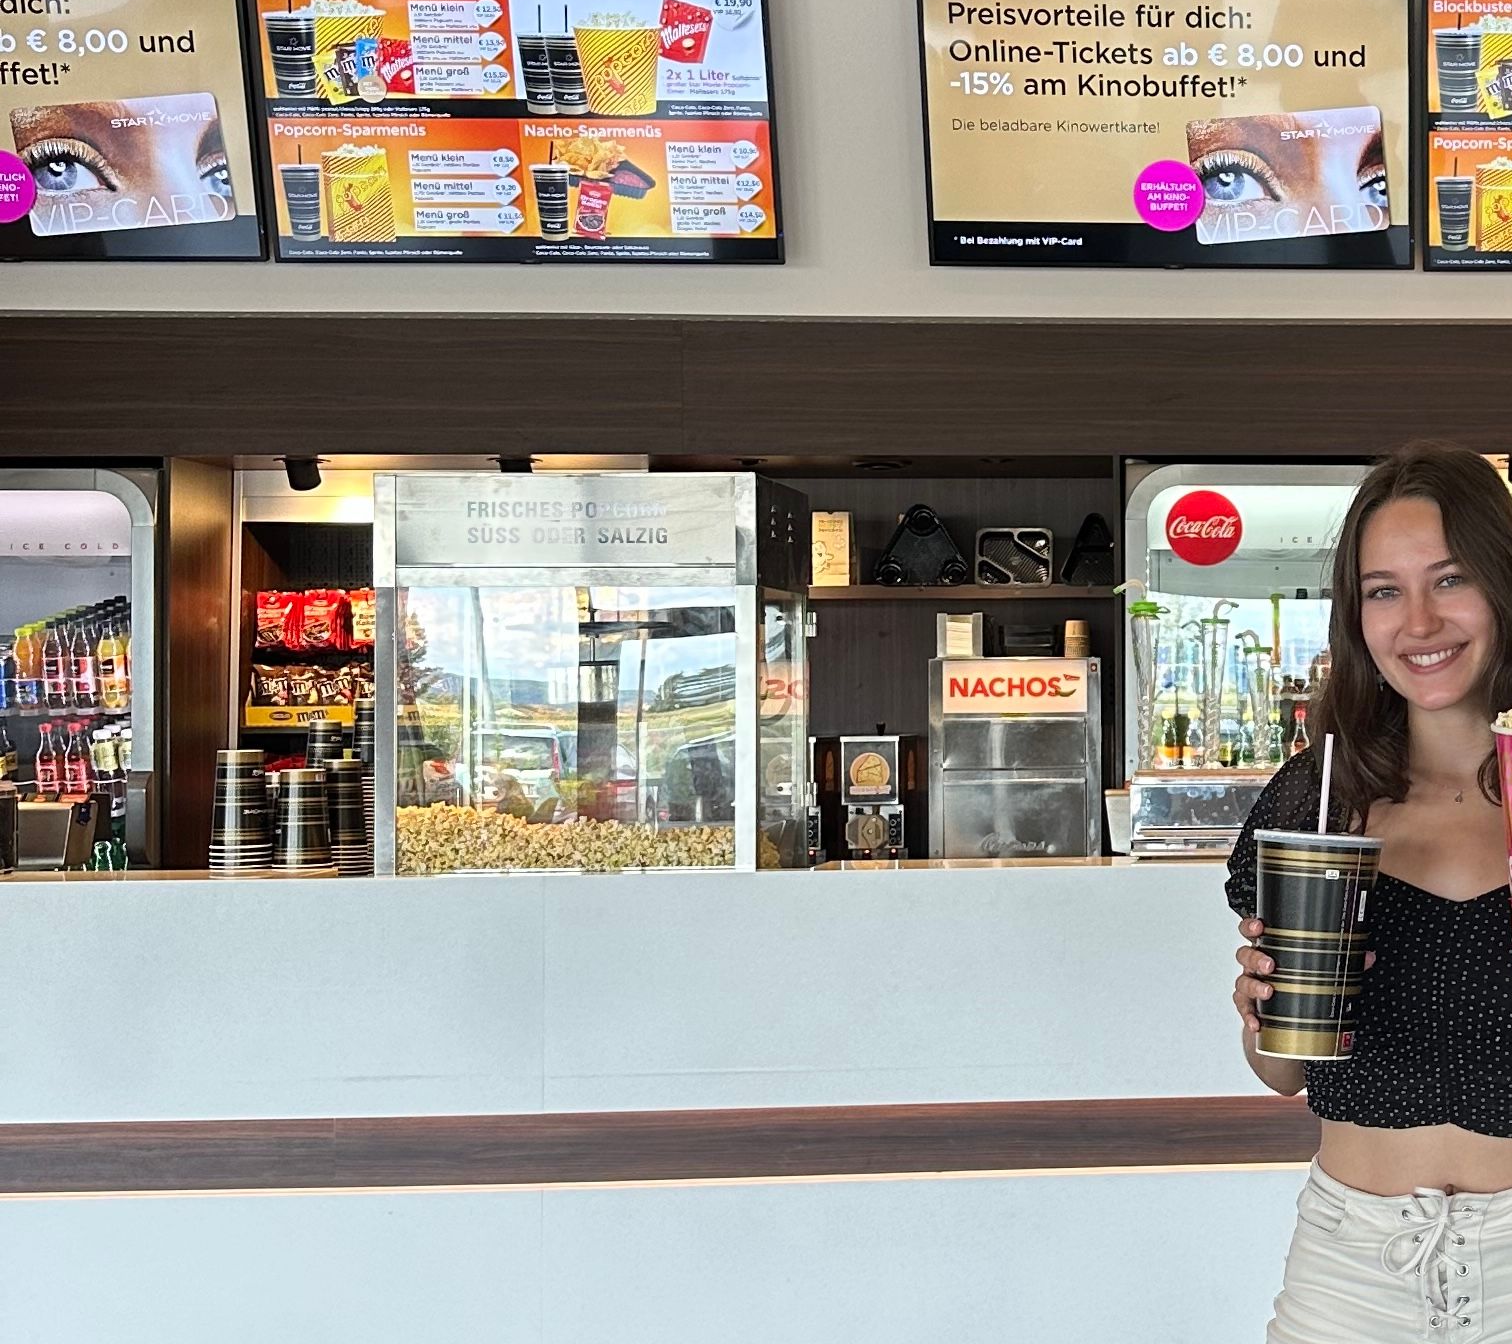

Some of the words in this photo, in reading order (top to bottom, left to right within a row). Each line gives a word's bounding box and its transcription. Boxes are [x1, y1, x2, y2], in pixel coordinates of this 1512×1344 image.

[947, 2, 1126, 27] Preisvorteile
[1136, 5, 1175, 28] für
[1185, 5, 1252, 29] dich:
[26, 29, 48, 53] €
[58, 29, 128, 56] 8,00
[139, 30, 195, 53] und
[949, 40, 1153, 66] Online-Tickets
[1163, 43, 1198, 67] ab
[1208, 44, 1228, 67] €
[1237, 44, 1304, 71] 8,00
[1314, 45, 1365, 68] und
[666, 69, 682, 81] 2x
[700, 68, 730, 81] Liter
[951, 72, 1014, 96] -15%
[1024, 79, 1066, 96] am
[111, 118, 147, 128] STAR
[169, 112, 211, 123] MOVIE
[952, 119, 974, 132] Die
[981, 119, 1051, 133] beladbare
[274, 123, 426, 138] Popcorn-Sparmenüs
[524, 125, 662, 139] Nacho-Sparmenüs
[1281, 130, 1316, 141] STAR
[1333, 124, 1375, 136] MOVIE
[30, 191, 228, 234] VIP-CARD
[1198, 203, 1383, 241] VIP-CARD
[467, 502, 563, 518] FRISCHES
[468, 523, 520, 543] SÜSS
[598, 528, 668, 543] SALZIG
[950, 676, 1062, 698] NACHOS
